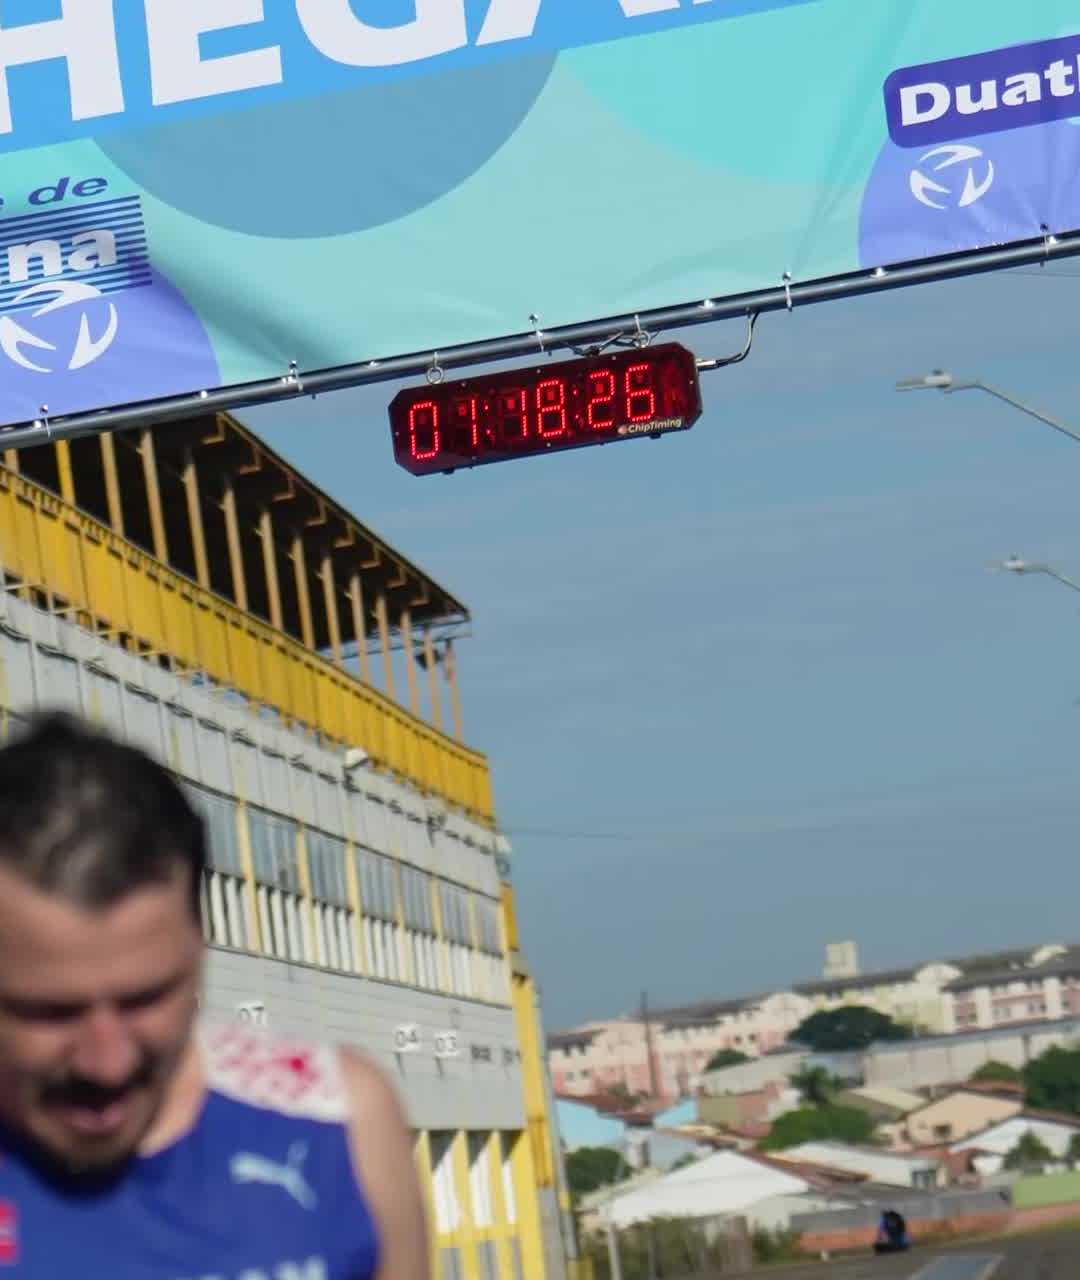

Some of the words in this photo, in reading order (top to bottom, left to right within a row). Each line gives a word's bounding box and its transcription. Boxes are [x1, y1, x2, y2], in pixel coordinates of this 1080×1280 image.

[900, 51, 1080, 126] Duat
[28, 176, 109, 206] de
[409, 363, 655, 460] 01:18:26
[628, 419, 682, 433] ChipTiming
